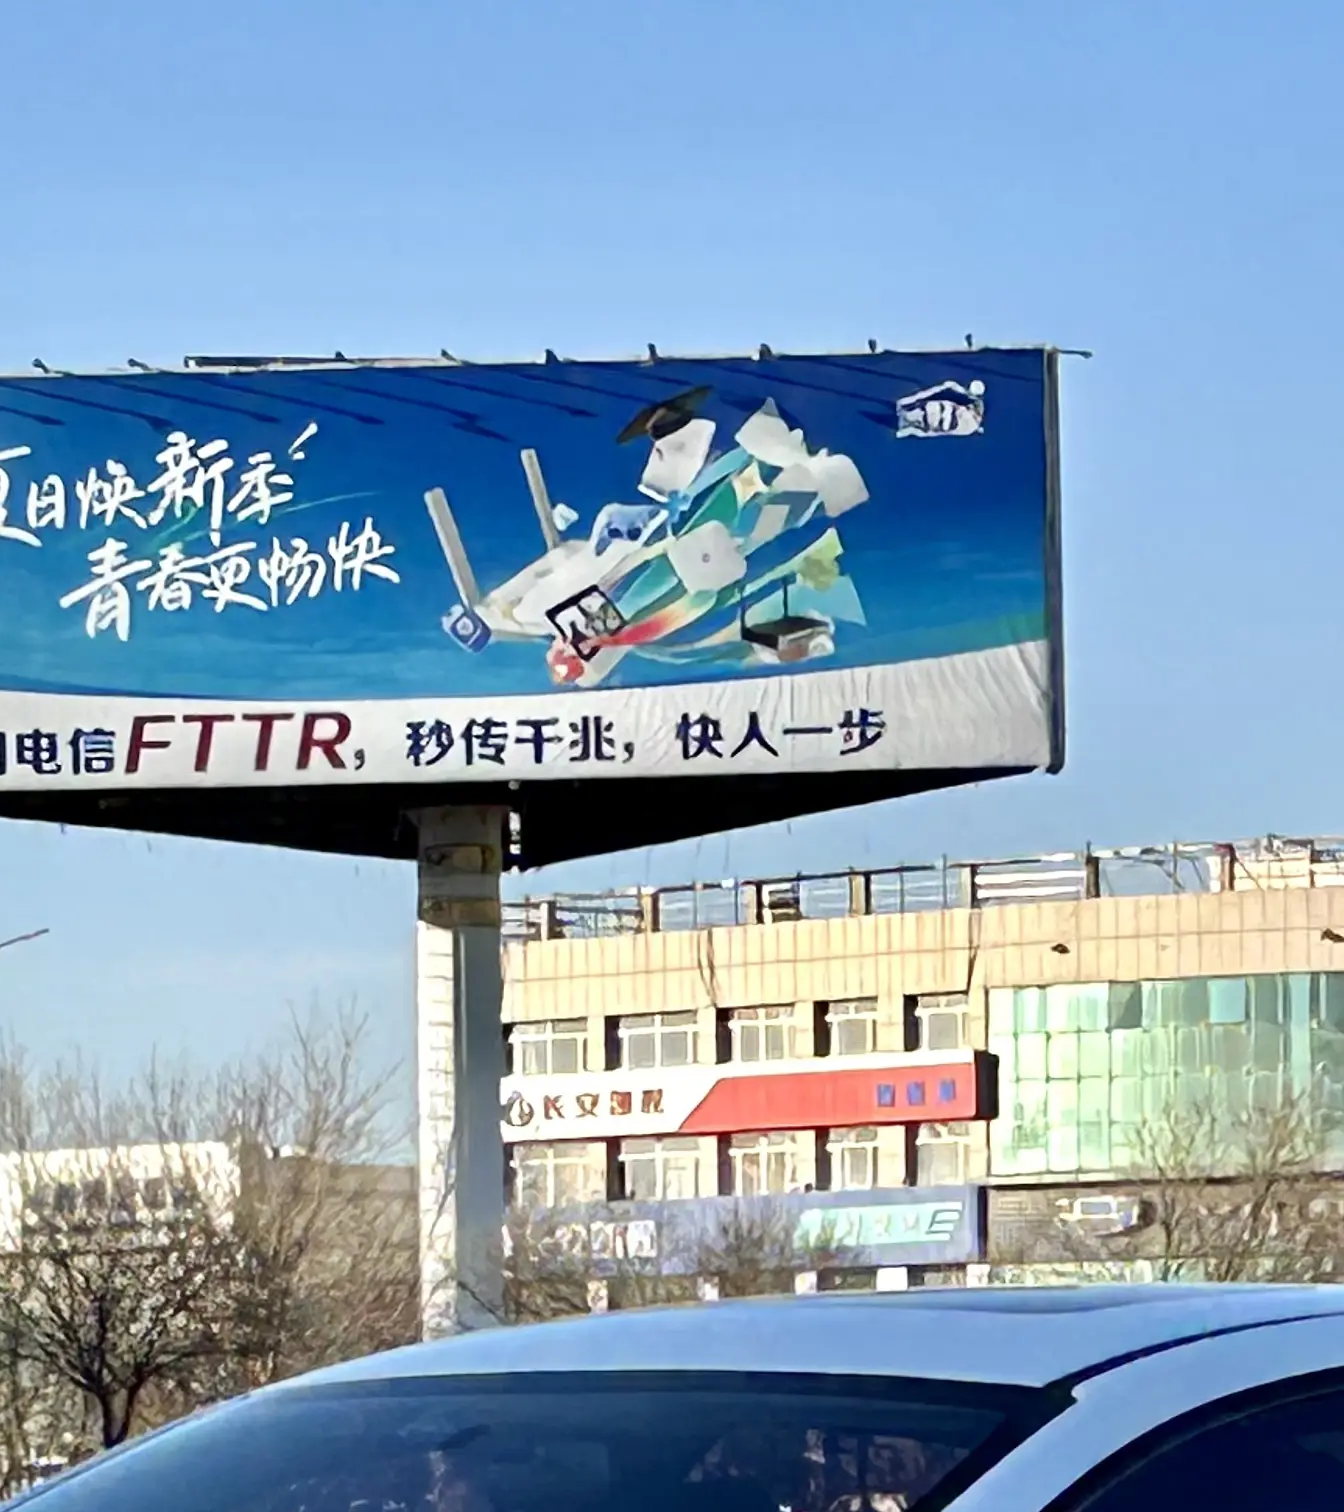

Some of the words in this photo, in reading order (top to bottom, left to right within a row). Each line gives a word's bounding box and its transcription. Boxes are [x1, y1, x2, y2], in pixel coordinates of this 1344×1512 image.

[59, 516, 400, 642] 青春更畅快
